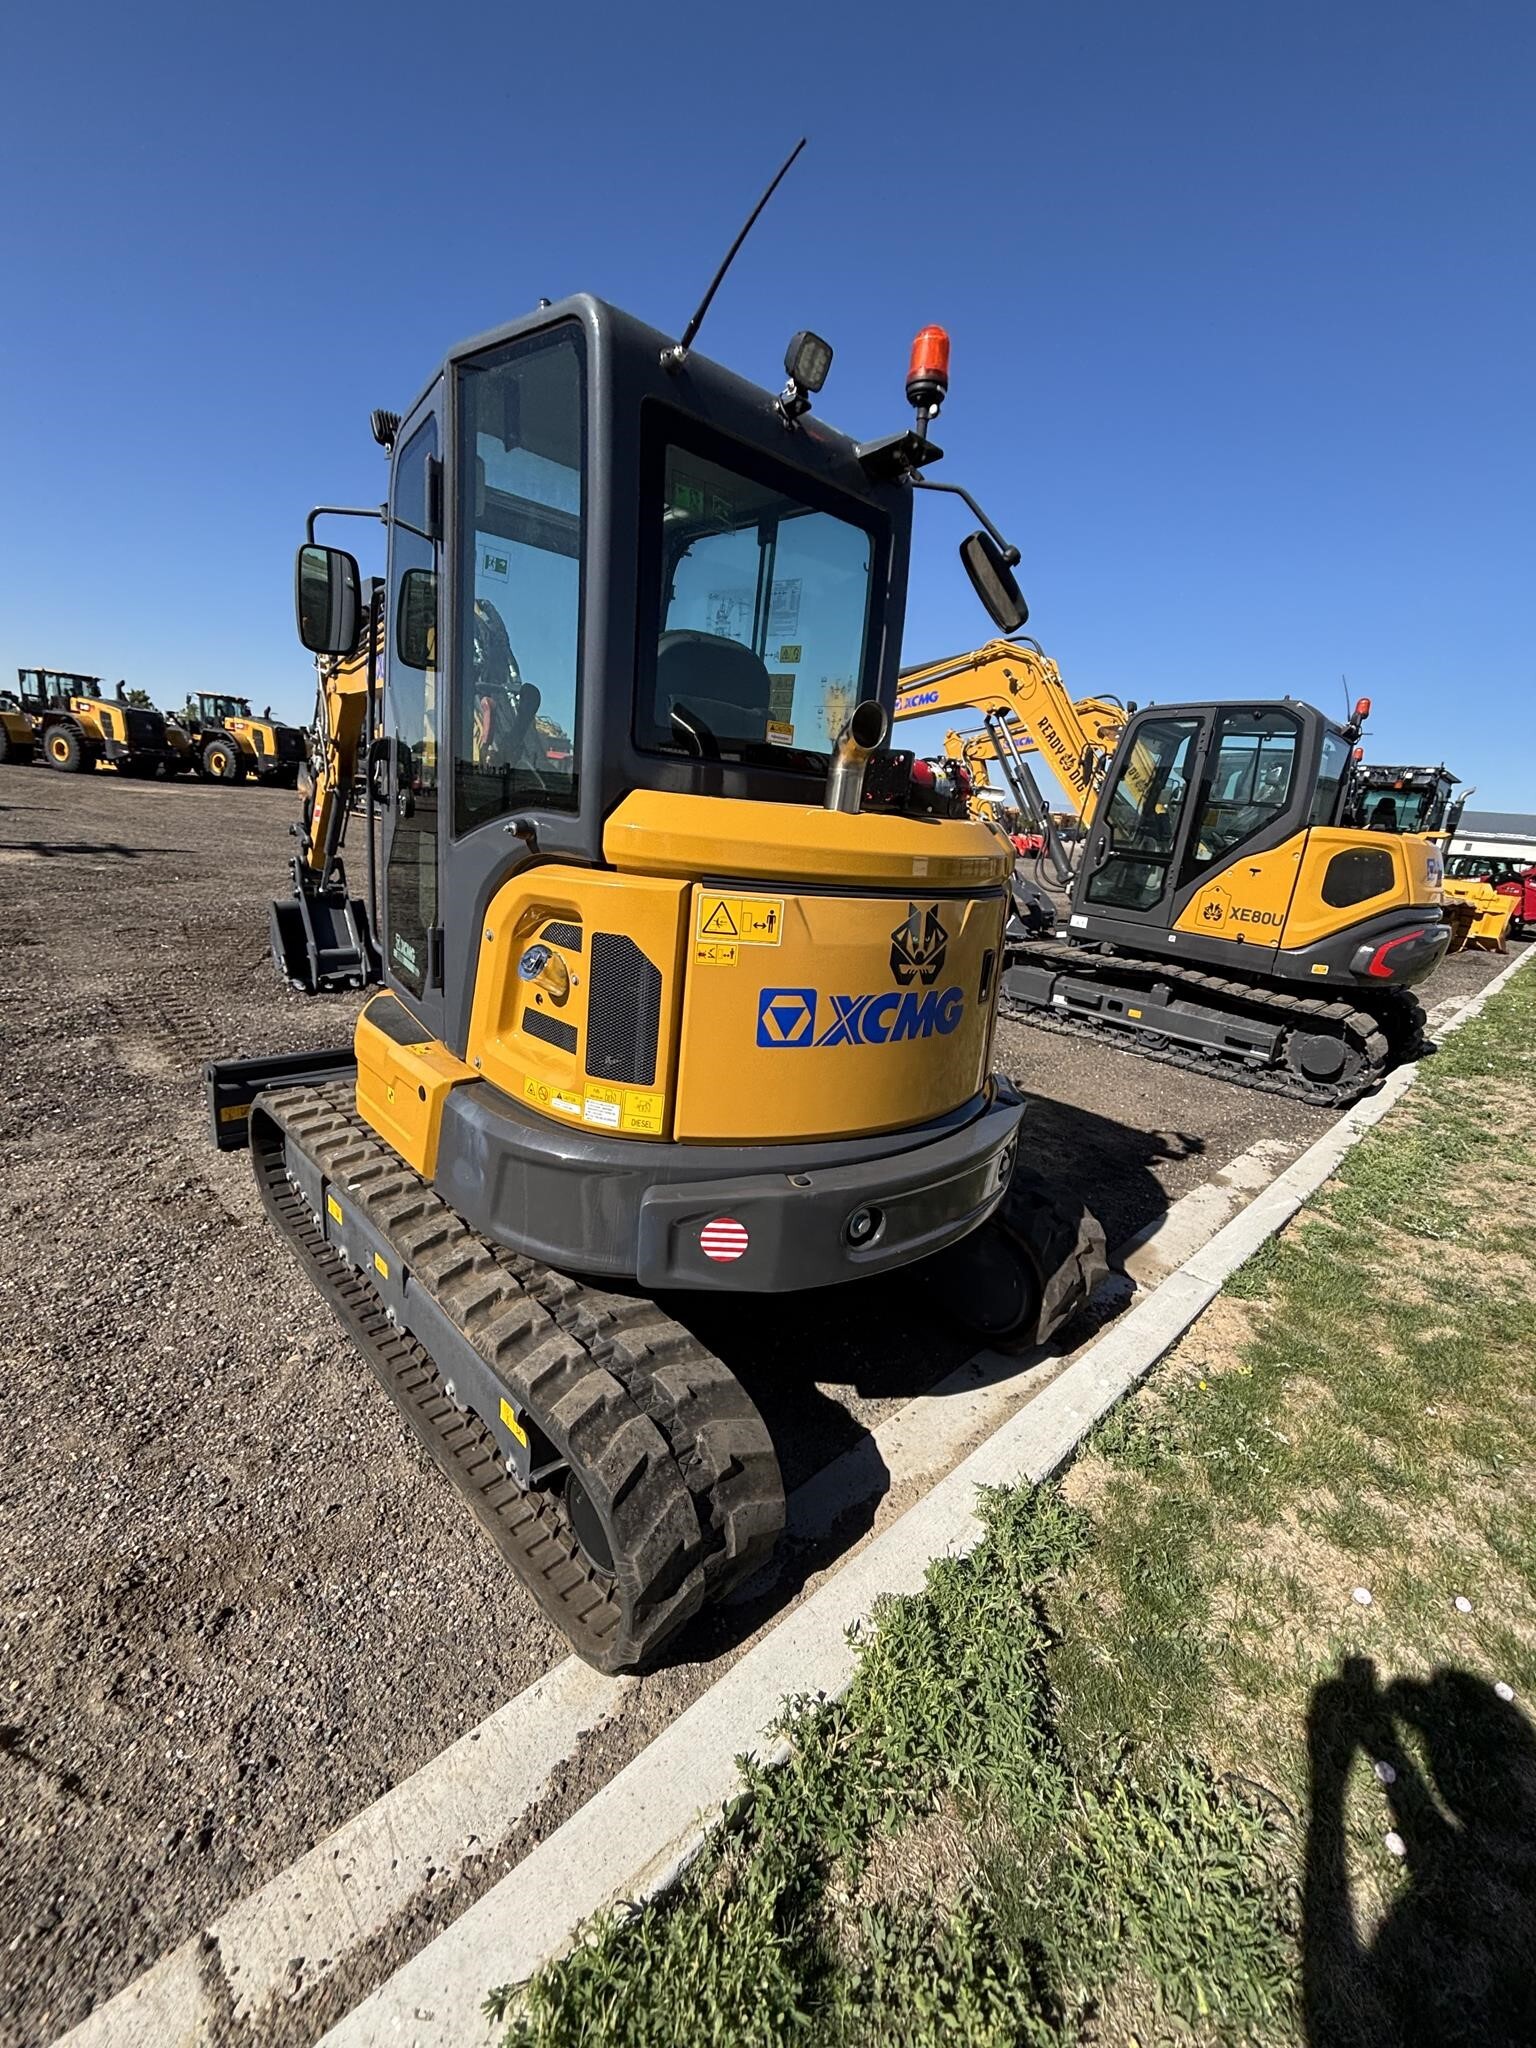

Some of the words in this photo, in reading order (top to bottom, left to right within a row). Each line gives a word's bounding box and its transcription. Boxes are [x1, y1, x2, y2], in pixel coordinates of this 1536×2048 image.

[904, 691, 939, 708] XCMG
[1038, 716, 1066, 755] READY
[1069, 768, 1086, 792] DIG
[1229, 906, 1284, 926] XE80U
[813, 985, 964, 1047] XCMG
[631, 1118, 654, 1129] DIESEL
